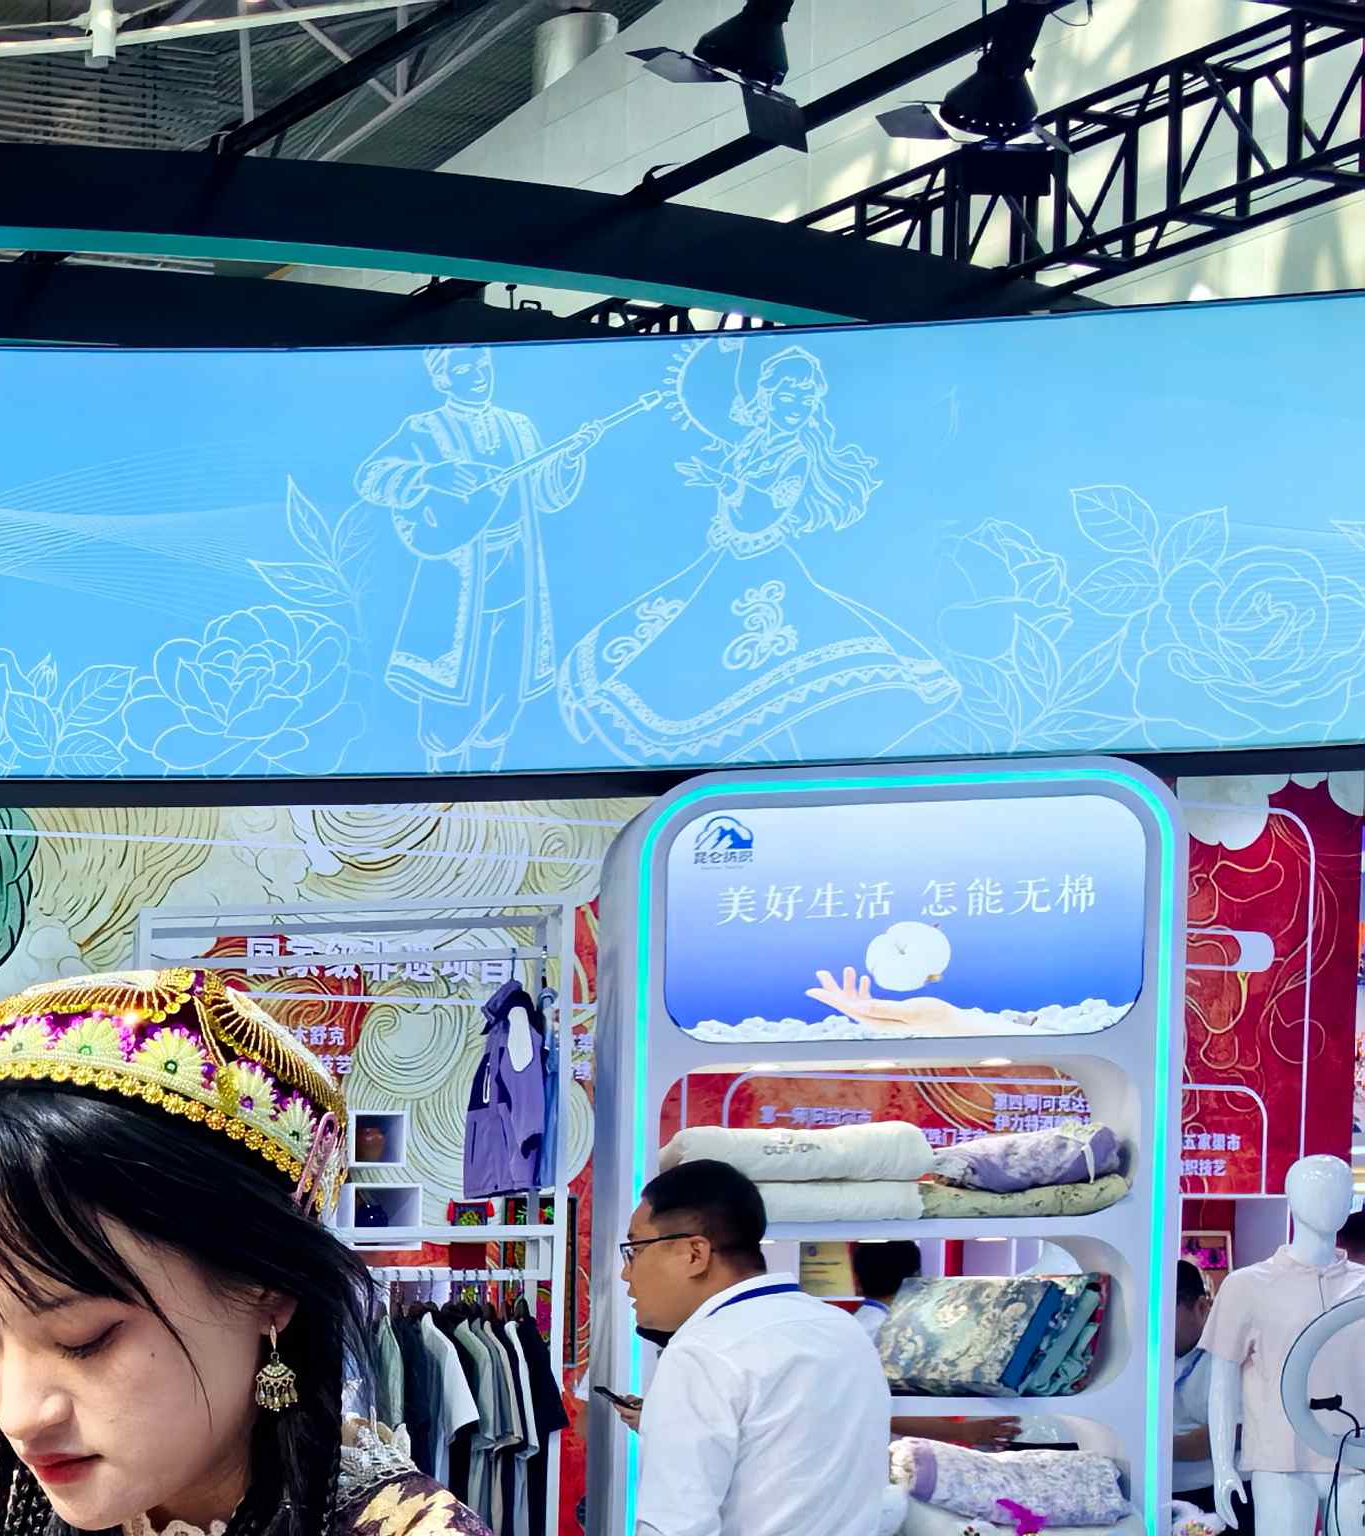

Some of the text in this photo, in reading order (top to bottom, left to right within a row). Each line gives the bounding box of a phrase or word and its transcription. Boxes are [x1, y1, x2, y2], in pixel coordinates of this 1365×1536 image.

[717, 874, 1097, 926] 美好生活 怎能无棉
